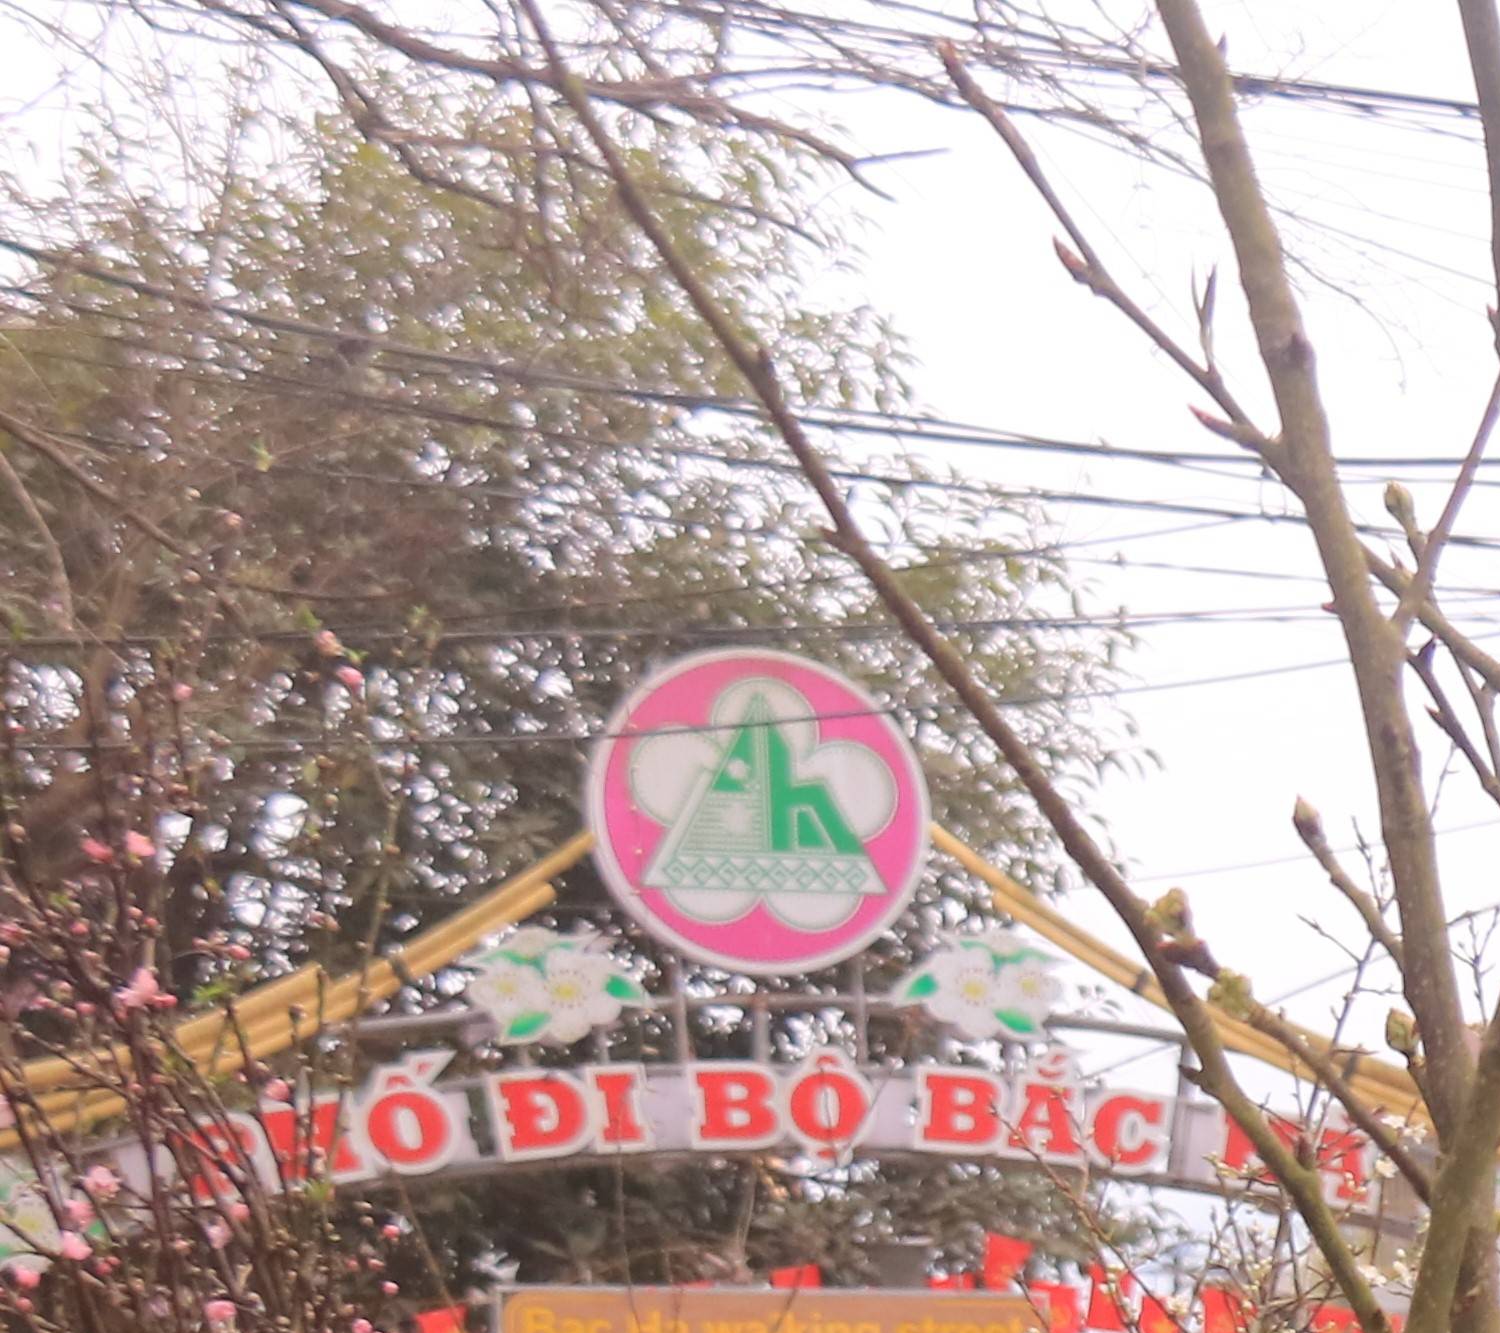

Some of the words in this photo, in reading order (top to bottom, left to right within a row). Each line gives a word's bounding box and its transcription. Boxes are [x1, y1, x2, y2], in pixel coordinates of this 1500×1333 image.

[502, 1072, 644, 1153] ĐI
[697, 1054, 870, 1160] BỘ
[922, 1051, 1164, 1167] BẮC
